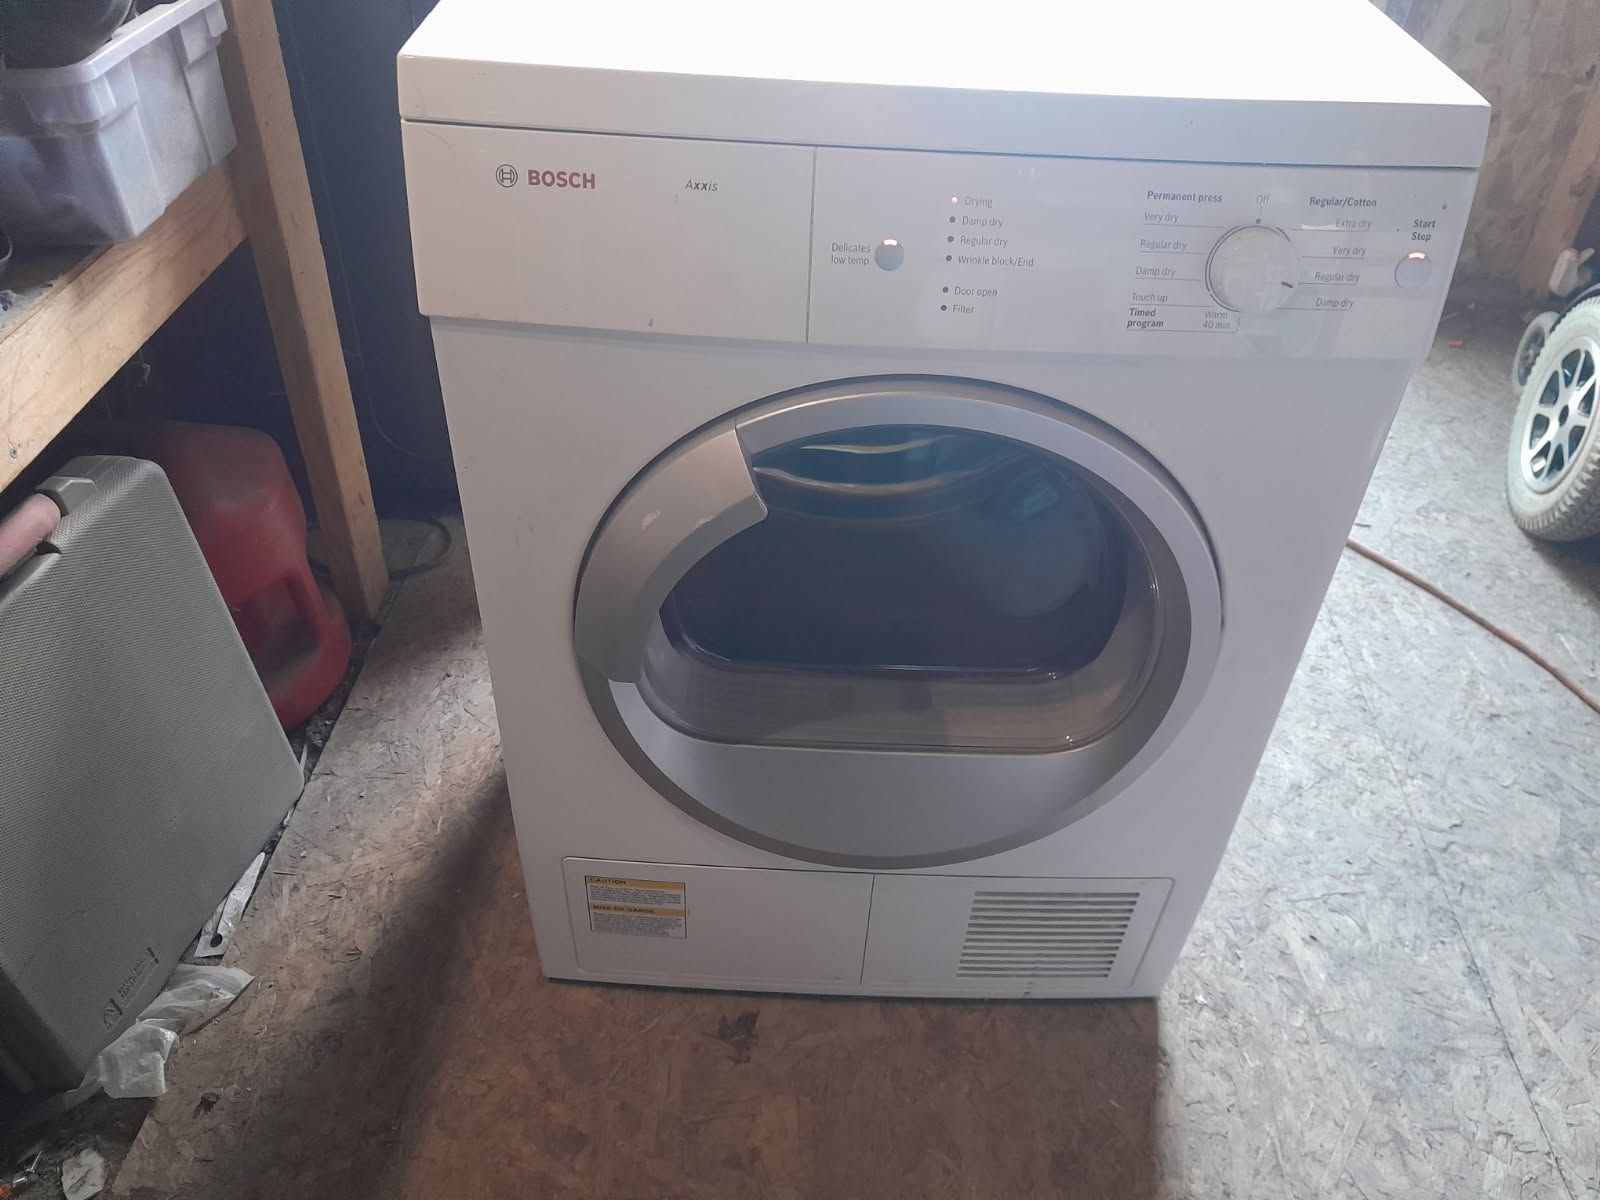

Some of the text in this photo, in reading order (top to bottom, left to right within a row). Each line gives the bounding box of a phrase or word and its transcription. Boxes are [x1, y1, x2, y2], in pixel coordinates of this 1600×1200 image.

[527, 169, 596, 189] BOSCH
[684, 179, 718, 192] Axxis
[964, 196, 993, 208] Drying
[1147, 190, 1223, 203] Permanent press
[1256, 194, 1270, 204] Off
[1309, 196, 1377, 208] Regular/Cotton
[962, 216, 1003, 228] Damp dry
[1144, 211, 1179, 224] Very dry
[1335, 218, 1373, 230] Extra dry
[1412, 219, 1436, 229] Start
[960, 236, 1008, 248] Regular dry
[1412, 232, 1432, 242] Stop
[831, 242, 871, 254] Delicates
[1140, 239, 1188, 251] Regular dry
[1333, 246, 1366, 258] Very dry
[831, 254, 872, 267] low temp.
[958, 255, 1034, 267] Wrinkle block/End
[1135, 266, 1176, 278] Damp dry
[1314, 272, 1360, 283] Regular dry
[954, 286, 998, 298] Door open
[1132, 292, 1168, 303] Touch up
[952, 304, 975, 314] Filter
[1316, 298, 1354, 309] Damp dry
[1128, 308, 1156, 317] Timed
[1204, 310, 1228, 320] Warm
[1126, 318, 1164, 329] program
[1202, 320, 1231, 329] 40 min
[590, 878, 627, 886] CAUTION
